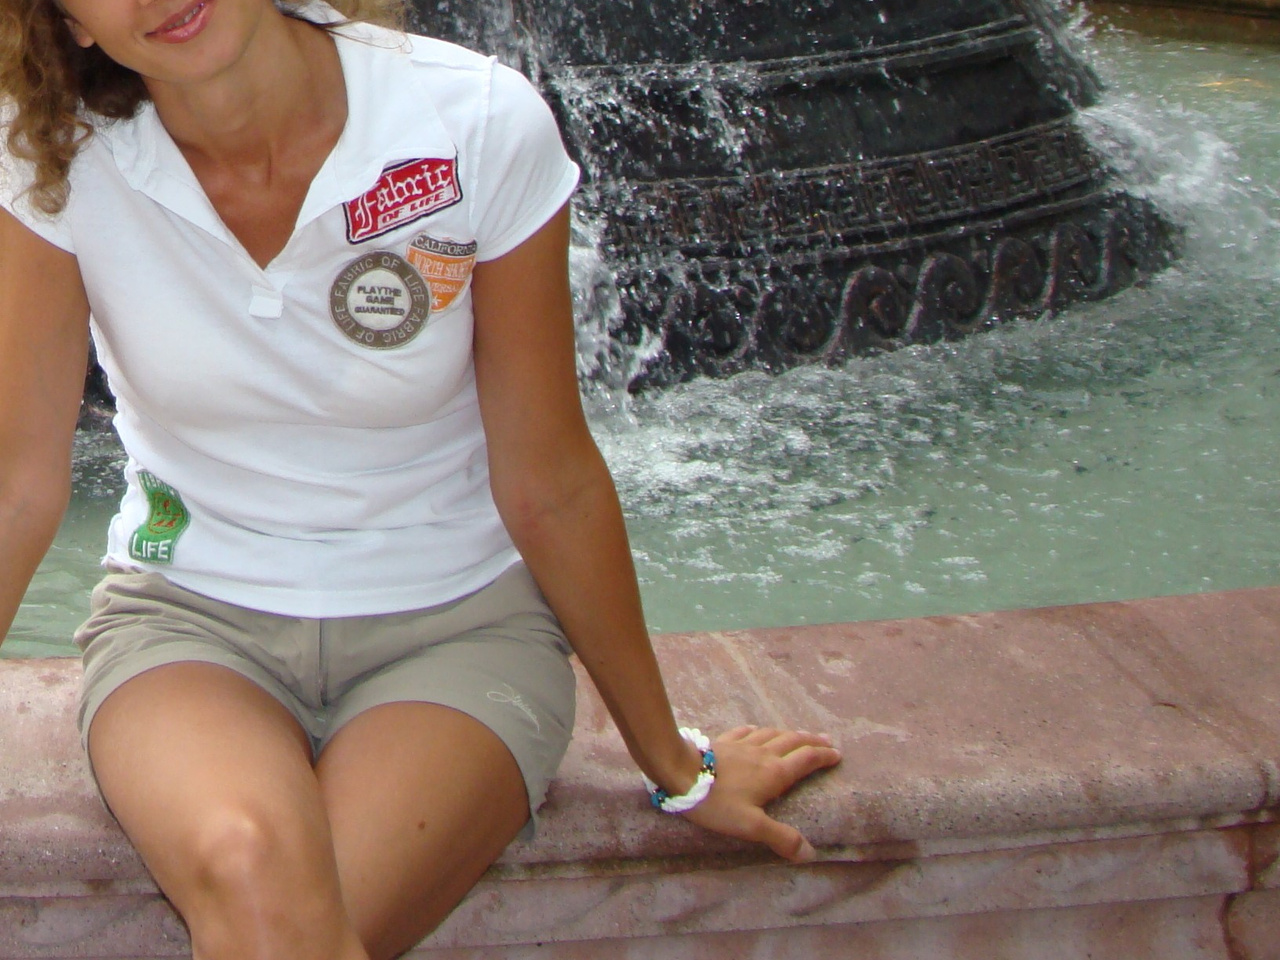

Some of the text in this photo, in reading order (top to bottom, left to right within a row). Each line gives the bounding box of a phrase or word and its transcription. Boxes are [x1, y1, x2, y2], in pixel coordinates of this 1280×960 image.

[349, 162, 452, 239] Fabric
[381, 191, 446, 224] OF LIFE
[334, 256, 425, 344] FABRIC OF LIFE FABRIC OF LIFE
[354, 306, 405, 316] GUARANTEED
[365, 295, 395, 305] GAME
[131, 532, 172, 559] LIFE
